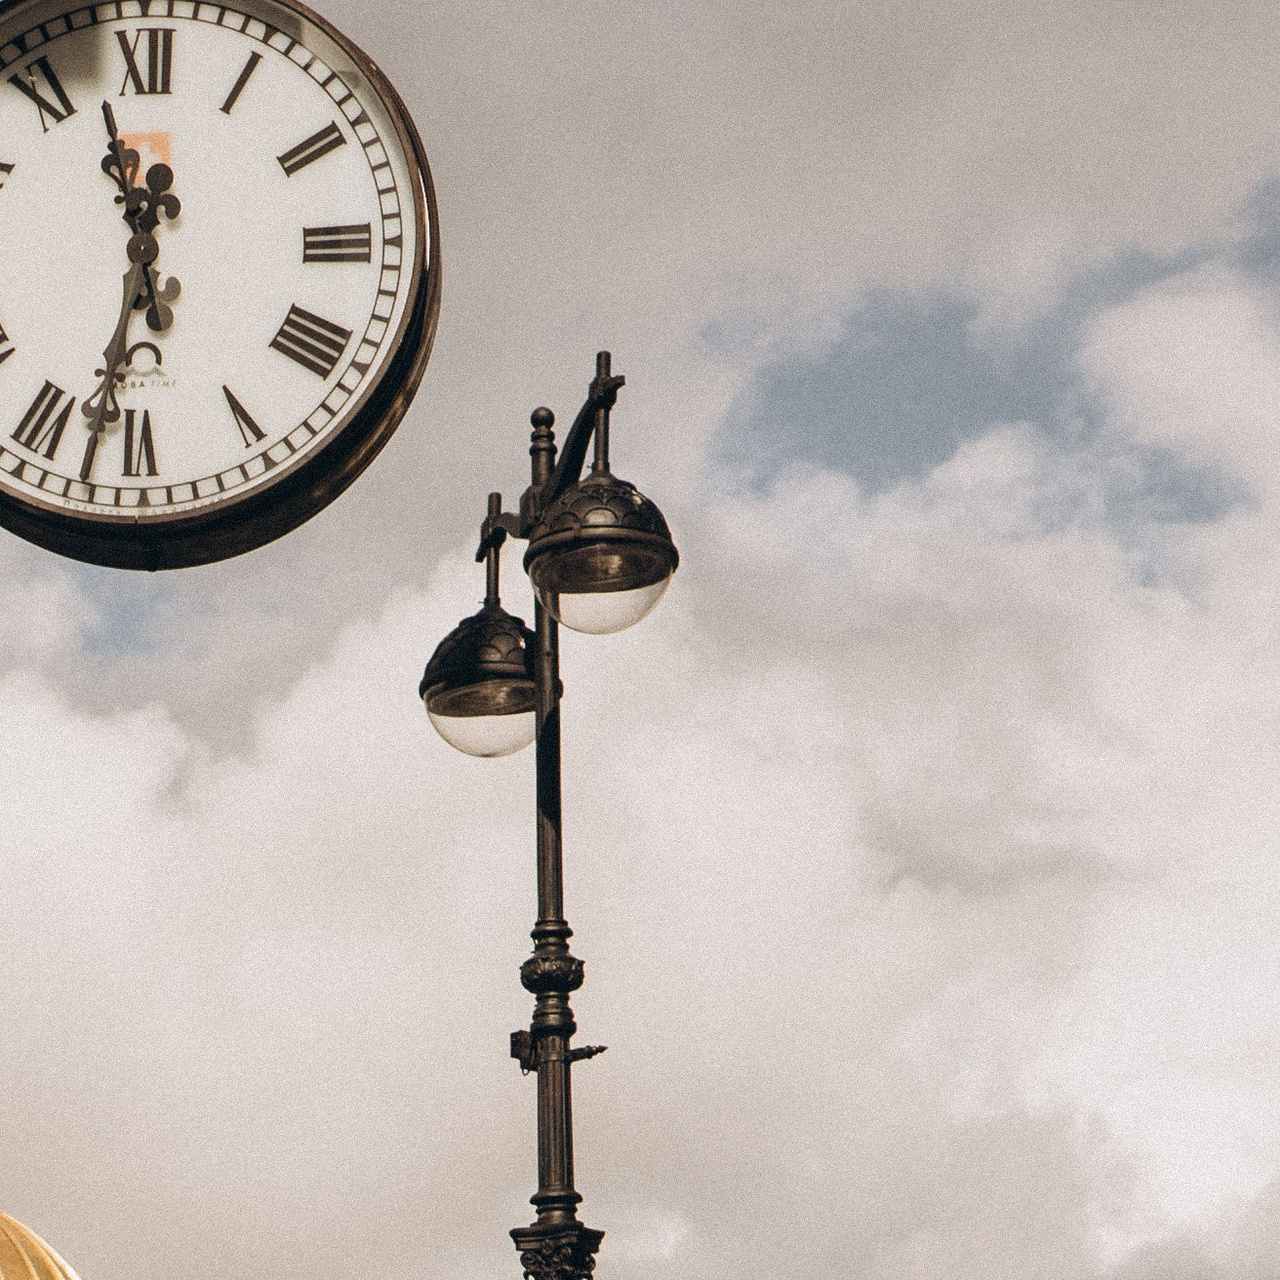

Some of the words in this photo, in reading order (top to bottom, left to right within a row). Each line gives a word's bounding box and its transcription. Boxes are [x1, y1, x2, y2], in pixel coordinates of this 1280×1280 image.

[8, 55, 78, 133] XI
[115, 28, 175, 96] XII
[221, 52, 262, 114] I
[277, 121, 348, 177] II
[303, 223, 371, 263] III
[11, 380, 75, 460] VII
[123, 409, 159, 476] VI
[223, 385, 266, 448] V
